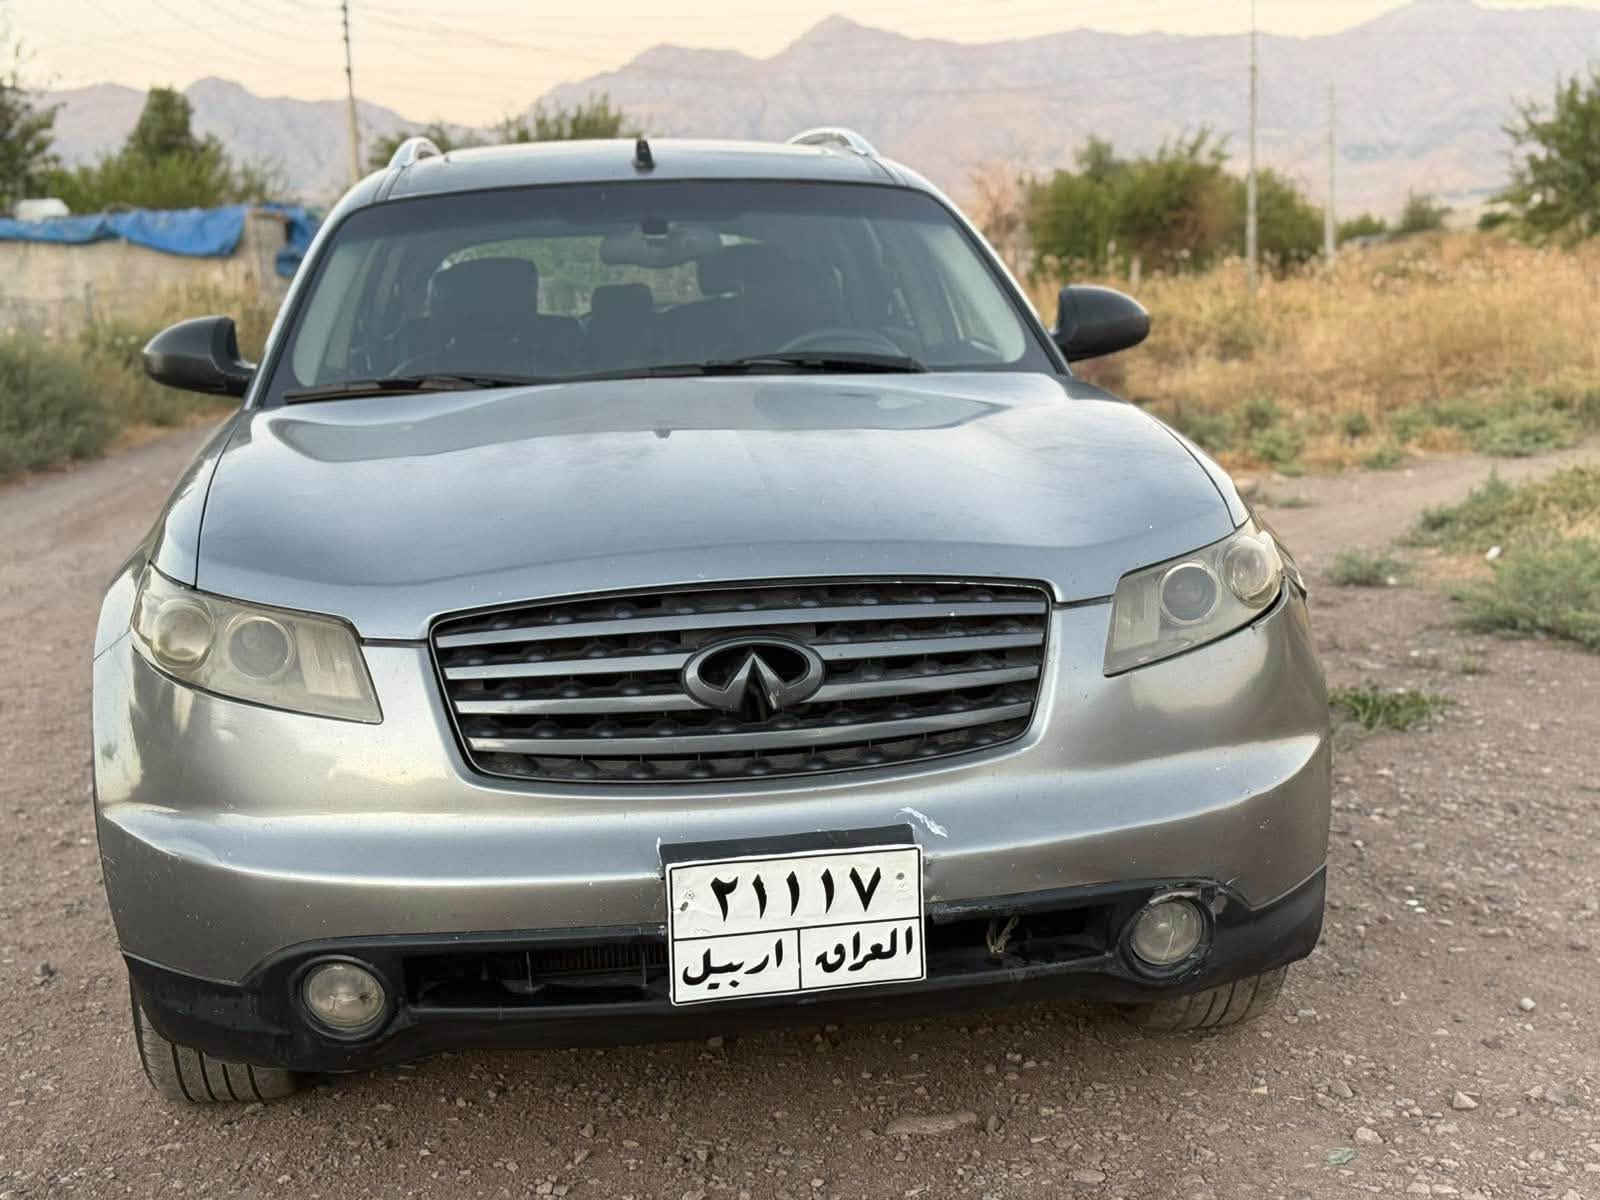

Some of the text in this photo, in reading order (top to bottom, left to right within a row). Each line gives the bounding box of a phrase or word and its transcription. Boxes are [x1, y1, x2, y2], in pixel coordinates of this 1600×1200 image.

[710, 867, 882, 922] ٢١١١٧
[682, 938, 783, 990] اربيل
[815, 925, 913, 973] العراق
